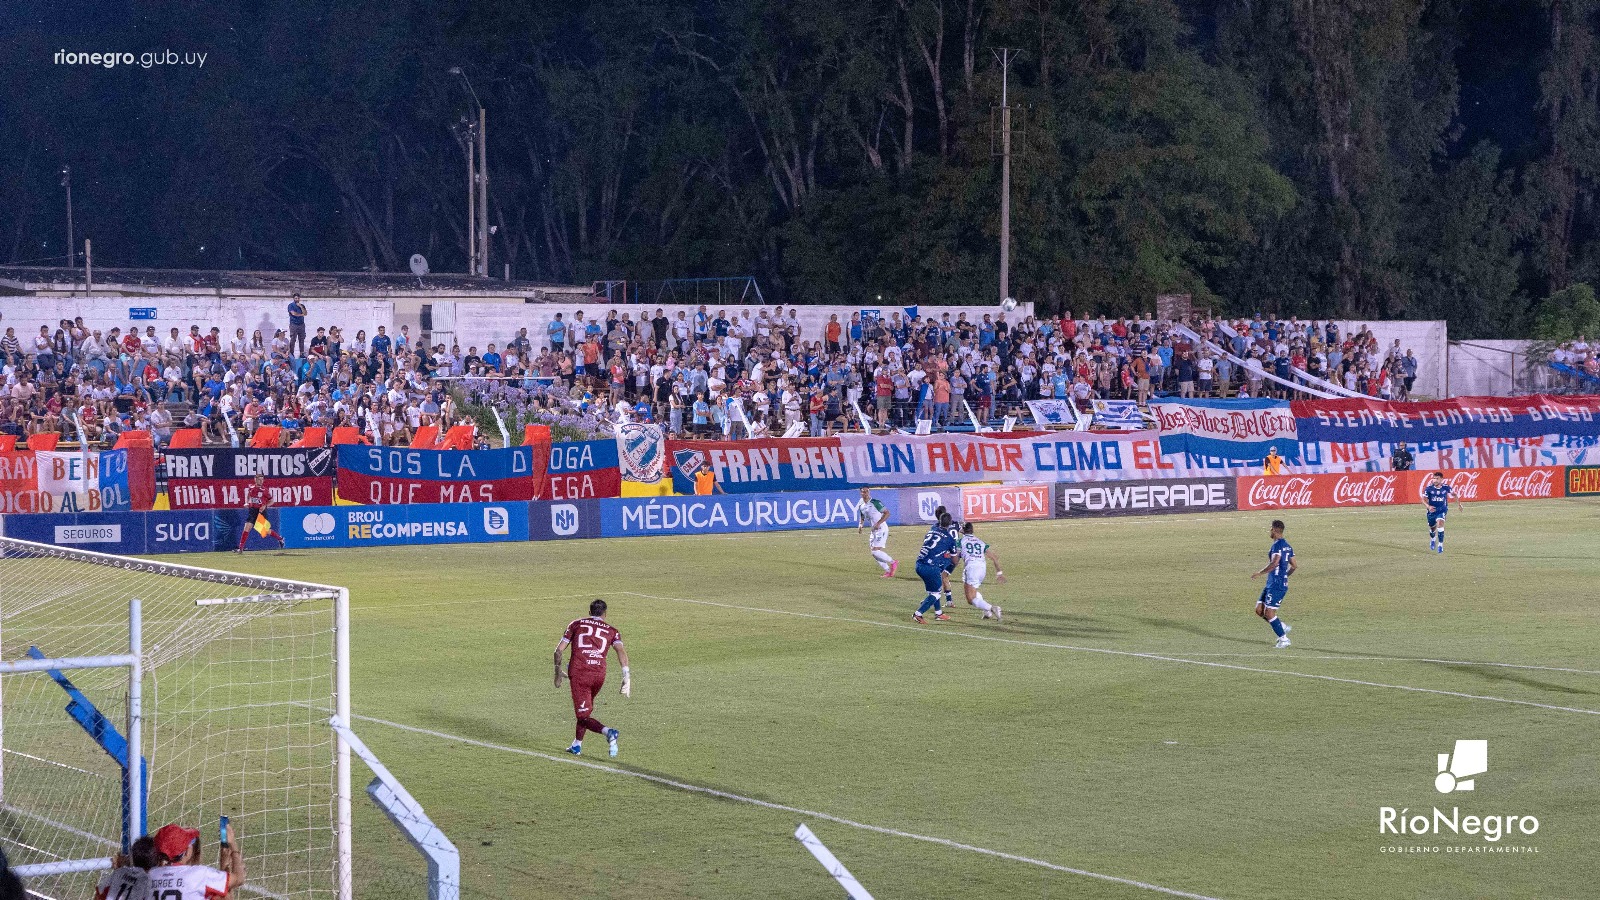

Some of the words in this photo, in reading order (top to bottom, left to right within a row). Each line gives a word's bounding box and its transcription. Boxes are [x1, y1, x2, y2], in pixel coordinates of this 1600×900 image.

[1151, 405, 1185, 432] Los
[1179, 407, 1230, 434] Pibes
[1227, 411, 1262, 439] Del
[1315, 408, 1413, 428] SIEMPRE
[1419, 406, 1514, 427] CONTIGO
[1526, 404, 1593, 422] BOLSO
[167, 453, 215, 478] FRAY
[234, 453, 306, 477] BENTOS
[369, 449, 422, 475] SOS
[437, 454, 476, 478] LA
[512, 444, 594, 473] DOGA
[709, 447, 783, 483] FRAY
[866, 442, 915, 474] UN
[927, 442, 1025, 473] AMOR
[1032, 440, 1123, 472] COMO
[1132, 439, 1174, 470] EL
[173, 485, 216, 506] filial
[222, 486, 240, 505] 14
[268, 485, 313, 507] mayo
[370, 481, 422, 505] QUE
[440, 484, 494, 503] MAS
[551, 475, 595, 501] EGA
[1065, 483, 1226, 511] POWERADE
[1248, 477, 1316, 507] Coca-Cola
[1333, 474, 1398, 504] Coca-Cola
[1497, 470, 1555, 497] Coca-Cola
[0, 489, 53, 514] ICTO
[60, 491, 86, 513] AL
[622, 498, 728, 530] MÉDICA
[967, 491, 1044, 515] PILSEN
[348, 511, 383, 524] BROU
[348, 521, 468, 540] RECOMPENSA
[63, 528, 113, 540] SEGUROS
[155, 522, 209, 542] sura
[965, 542, 982, 555] 99
[578, 624, 609, 653] 25
